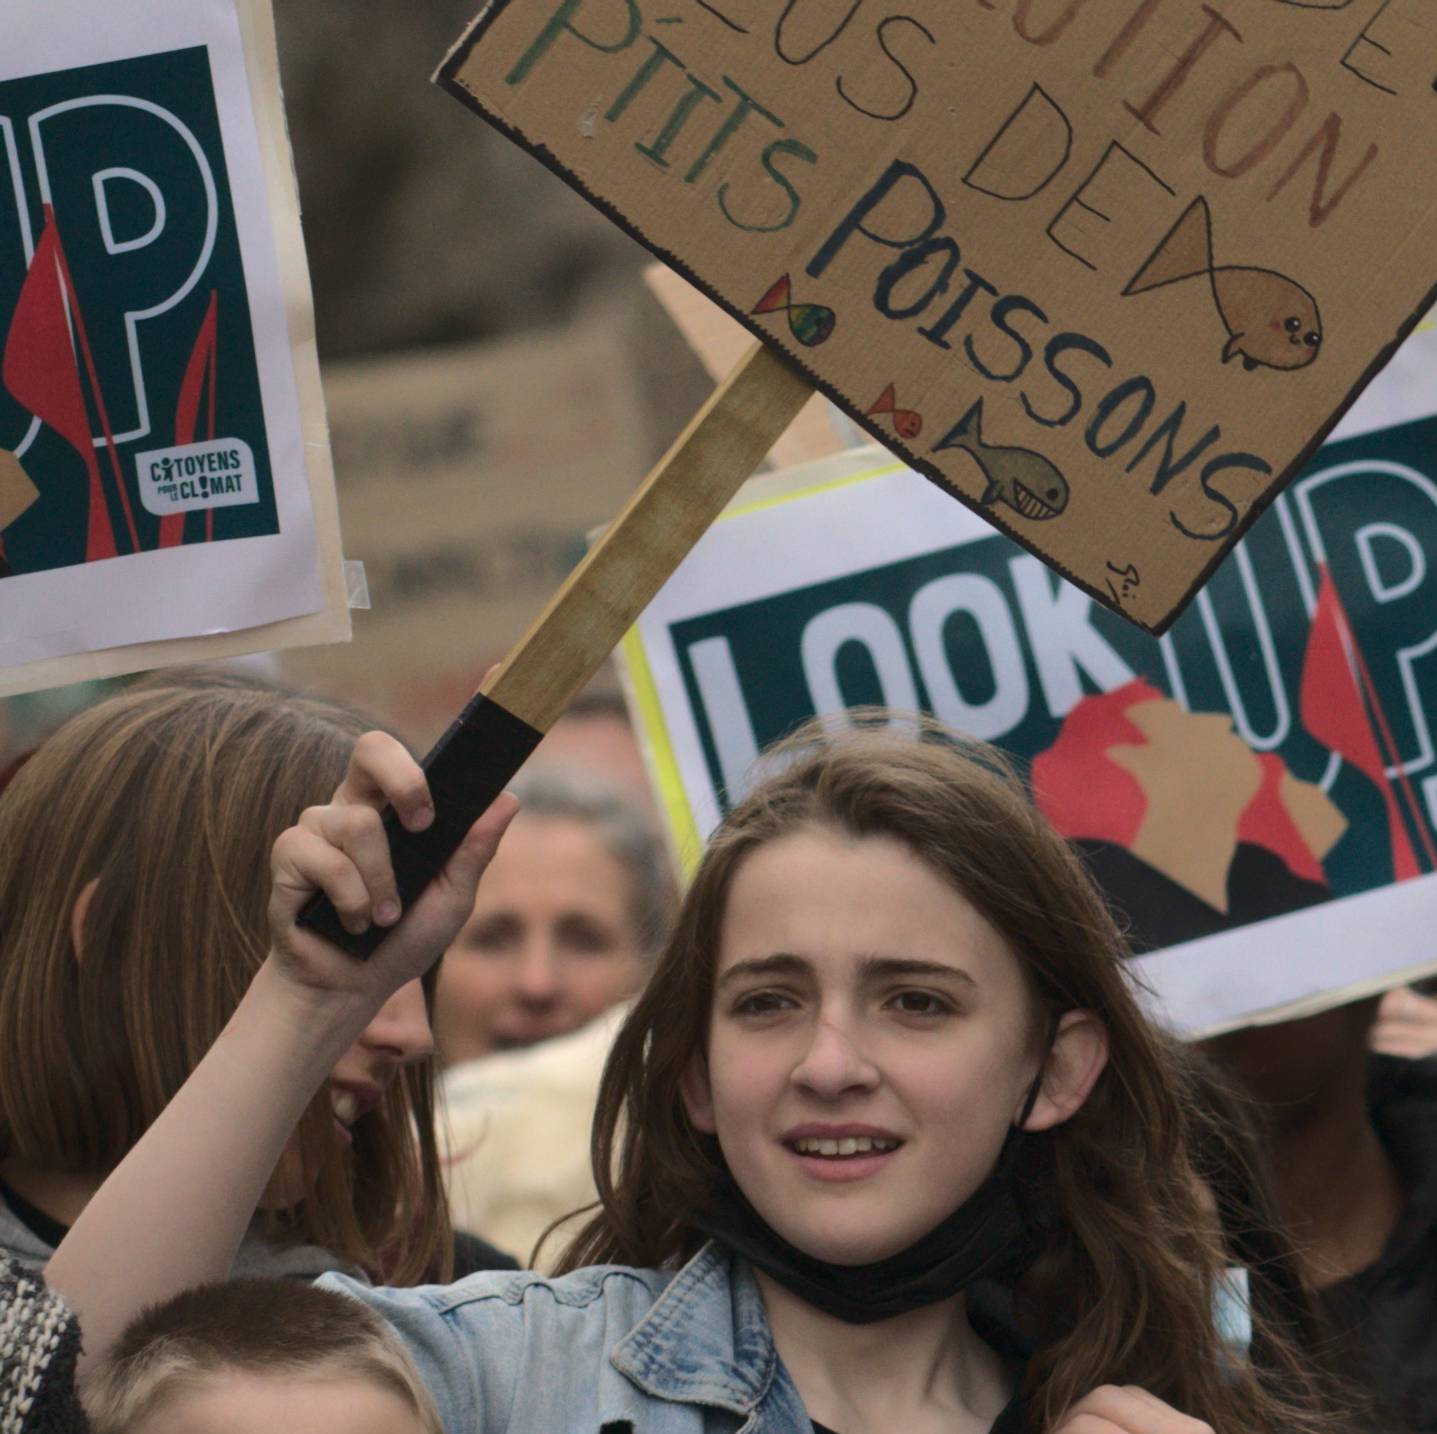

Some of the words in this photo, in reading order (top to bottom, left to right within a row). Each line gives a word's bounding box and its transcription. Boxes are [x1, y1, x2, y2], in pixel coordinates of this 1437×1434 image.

[0, 95, 218, 448] P
[962, 82, 1176, 271] DE
[806, 158, 1272, 541] POISSONS
[686, 555, 1138, 806] LOOK
